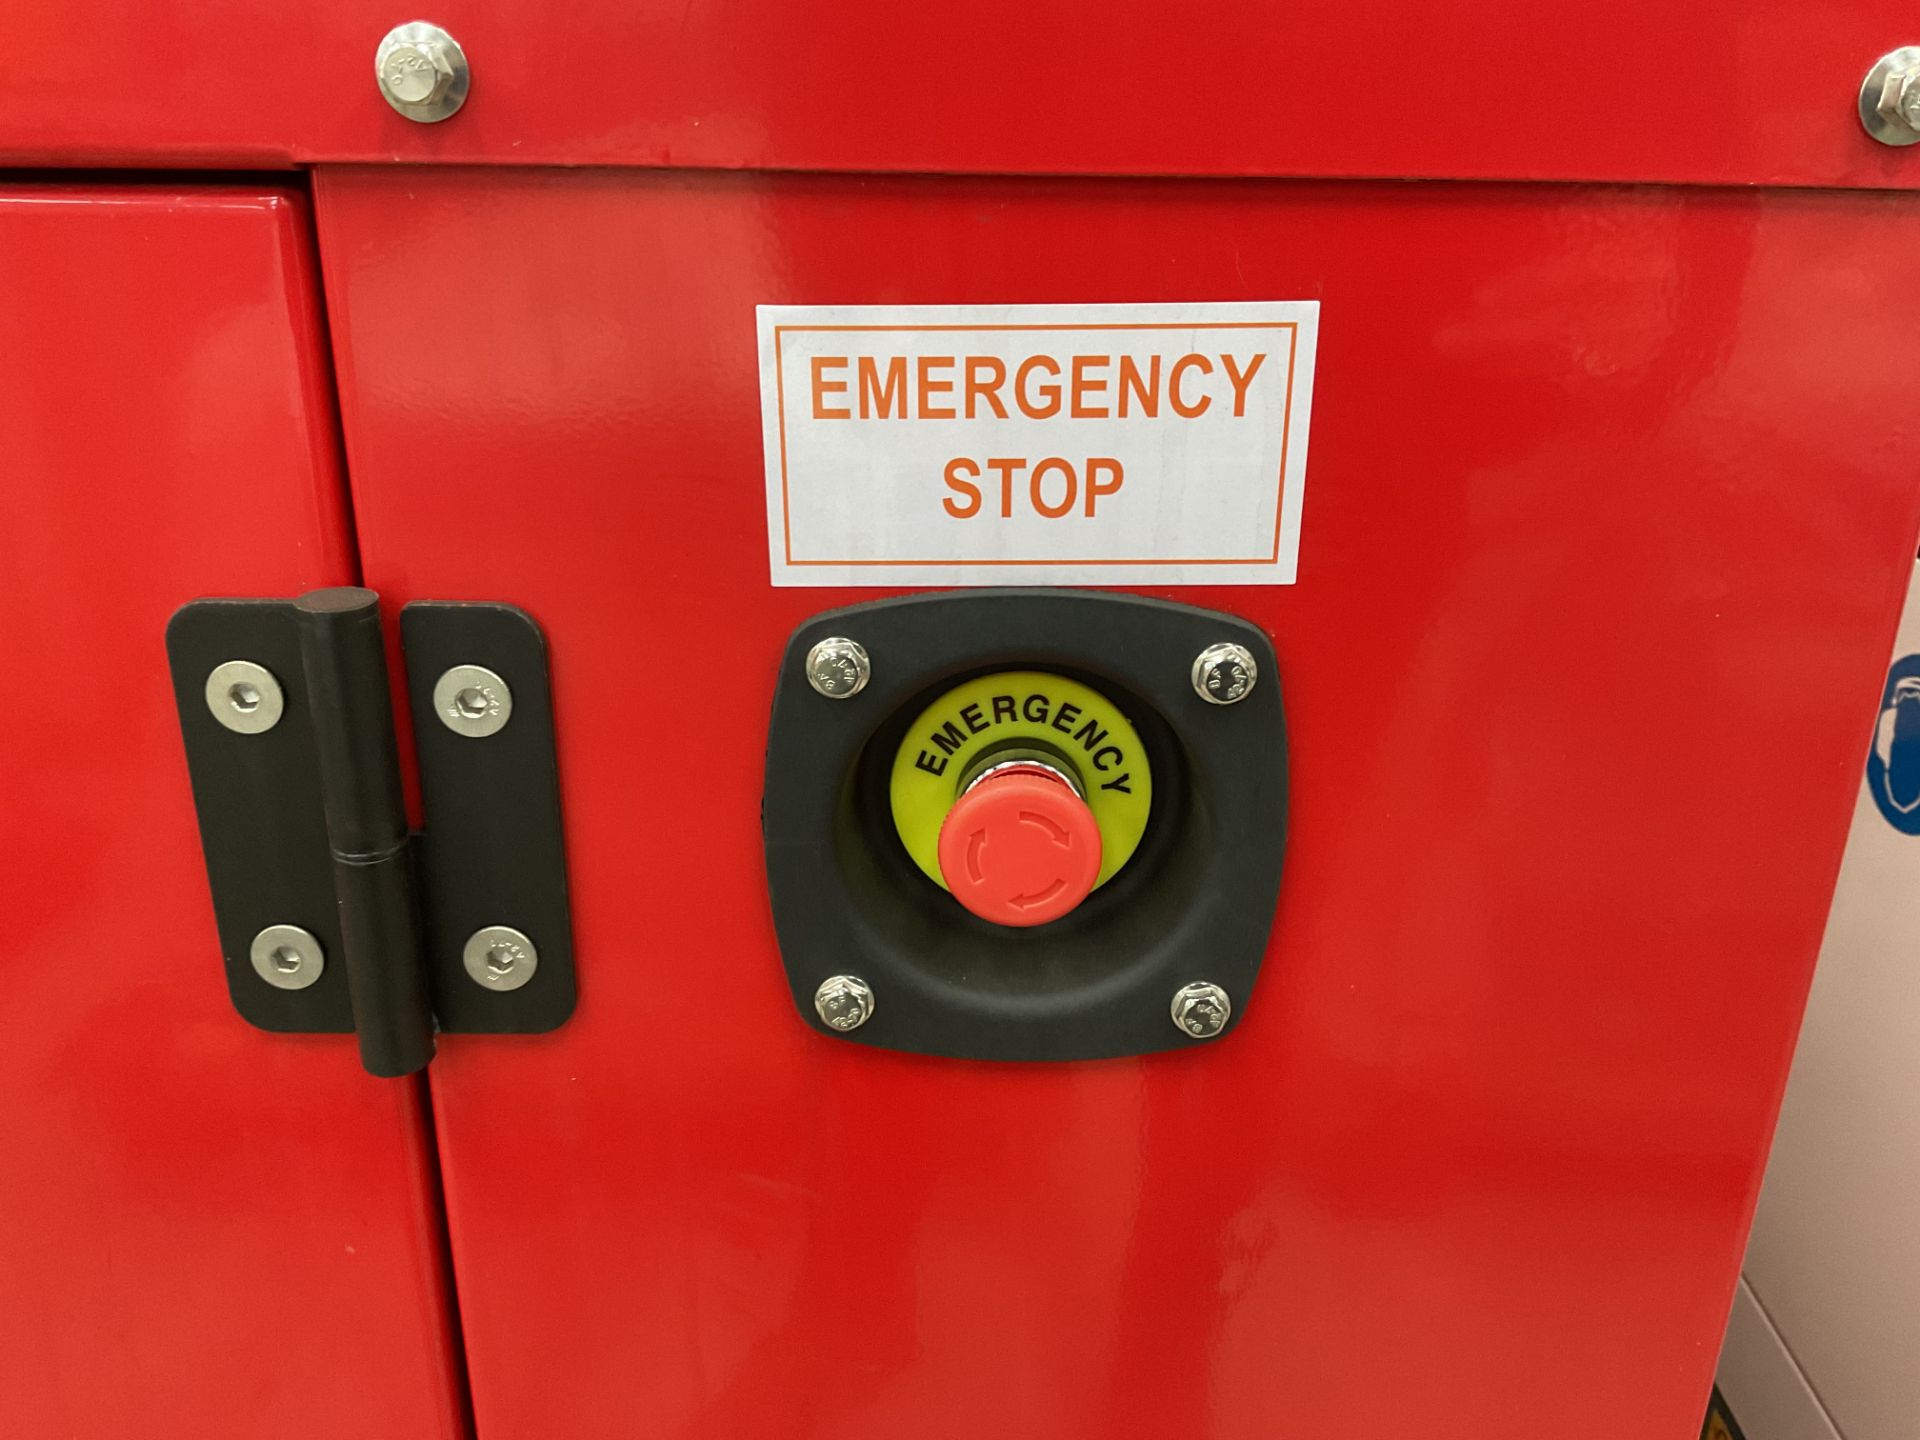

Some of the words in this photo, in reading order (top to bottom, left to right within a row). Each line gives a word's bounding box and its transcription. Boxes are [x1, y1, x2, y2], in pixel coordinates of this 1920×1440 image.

[810, 353, 1267, 420] EMERGENCY
[942, 457, 1124, 519] STOP
[915, 694, 1132, 795] EMERGENCY
